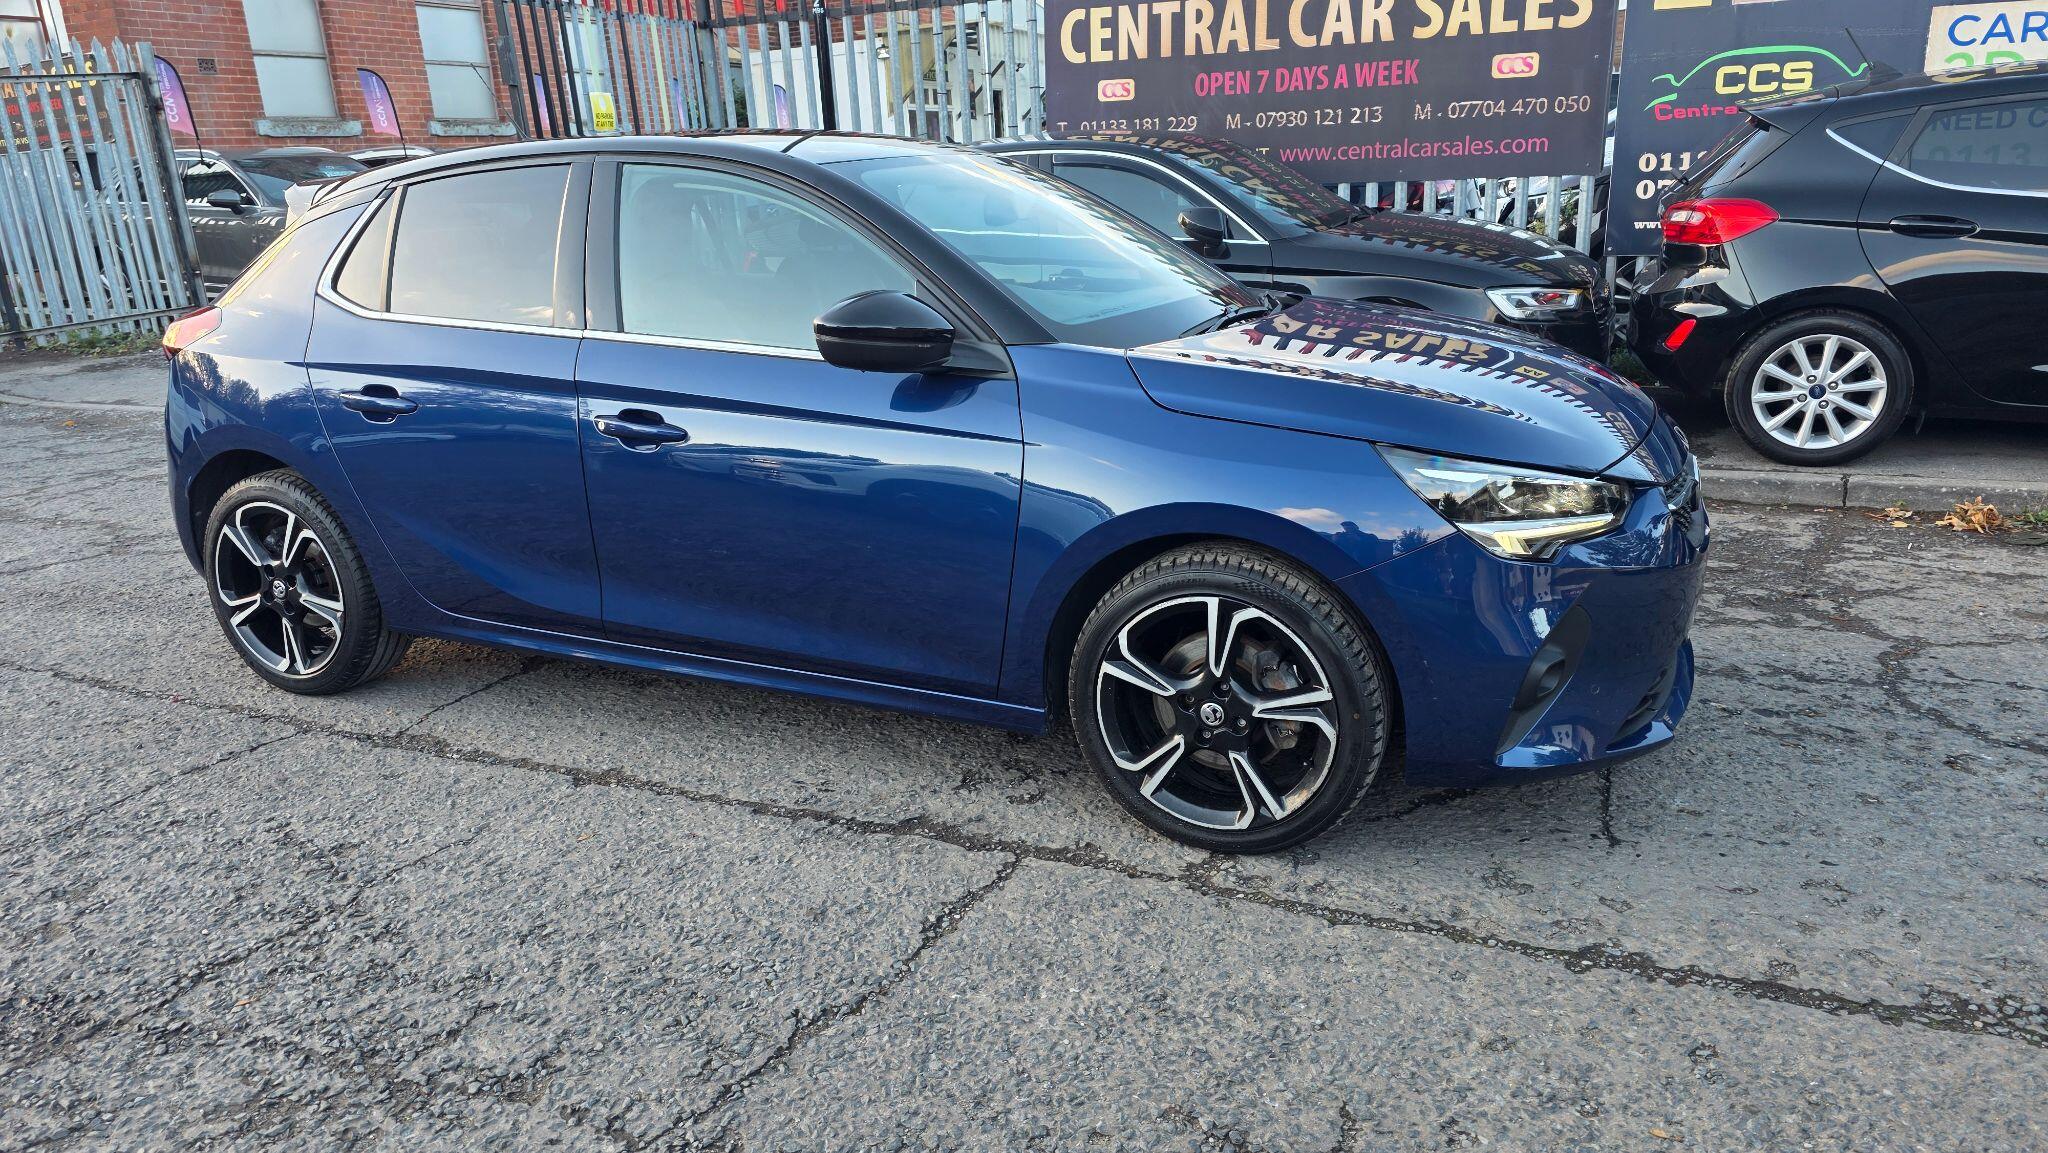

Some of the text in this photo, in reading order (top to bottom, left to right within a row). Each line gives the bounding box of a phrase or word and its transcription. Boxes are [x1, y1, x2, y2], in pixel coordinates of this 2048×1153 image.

[1060, 0, 1593, 64] CENTRAL CAR SALES
[1194, 58, 1420, 97] OPEN 7 DAYS A WEEK
[1715, 60, 1814, 95] CCS
[1134, 117, 1160, 131] 181
[1167, 115, 1198, 131] 229
[1226, 113, 1241, 129] M
[1255, 110, 1308, 128] 07930
[1314, 108, 1342, 125] 121
[1350, 105, 1383, 124] 213
[1414, 103, 1432, 121] M
[1447, 99, 1506, 119] 07704
[1511, 97, 1548, 115] 470
[1554, 95, 1591, 114] 050
[1654, 104, 1739, 121] Centra
[1280, 135, 1550, 162] www.centralcarsales.com
[1638, 151, 1708, 173] 011
